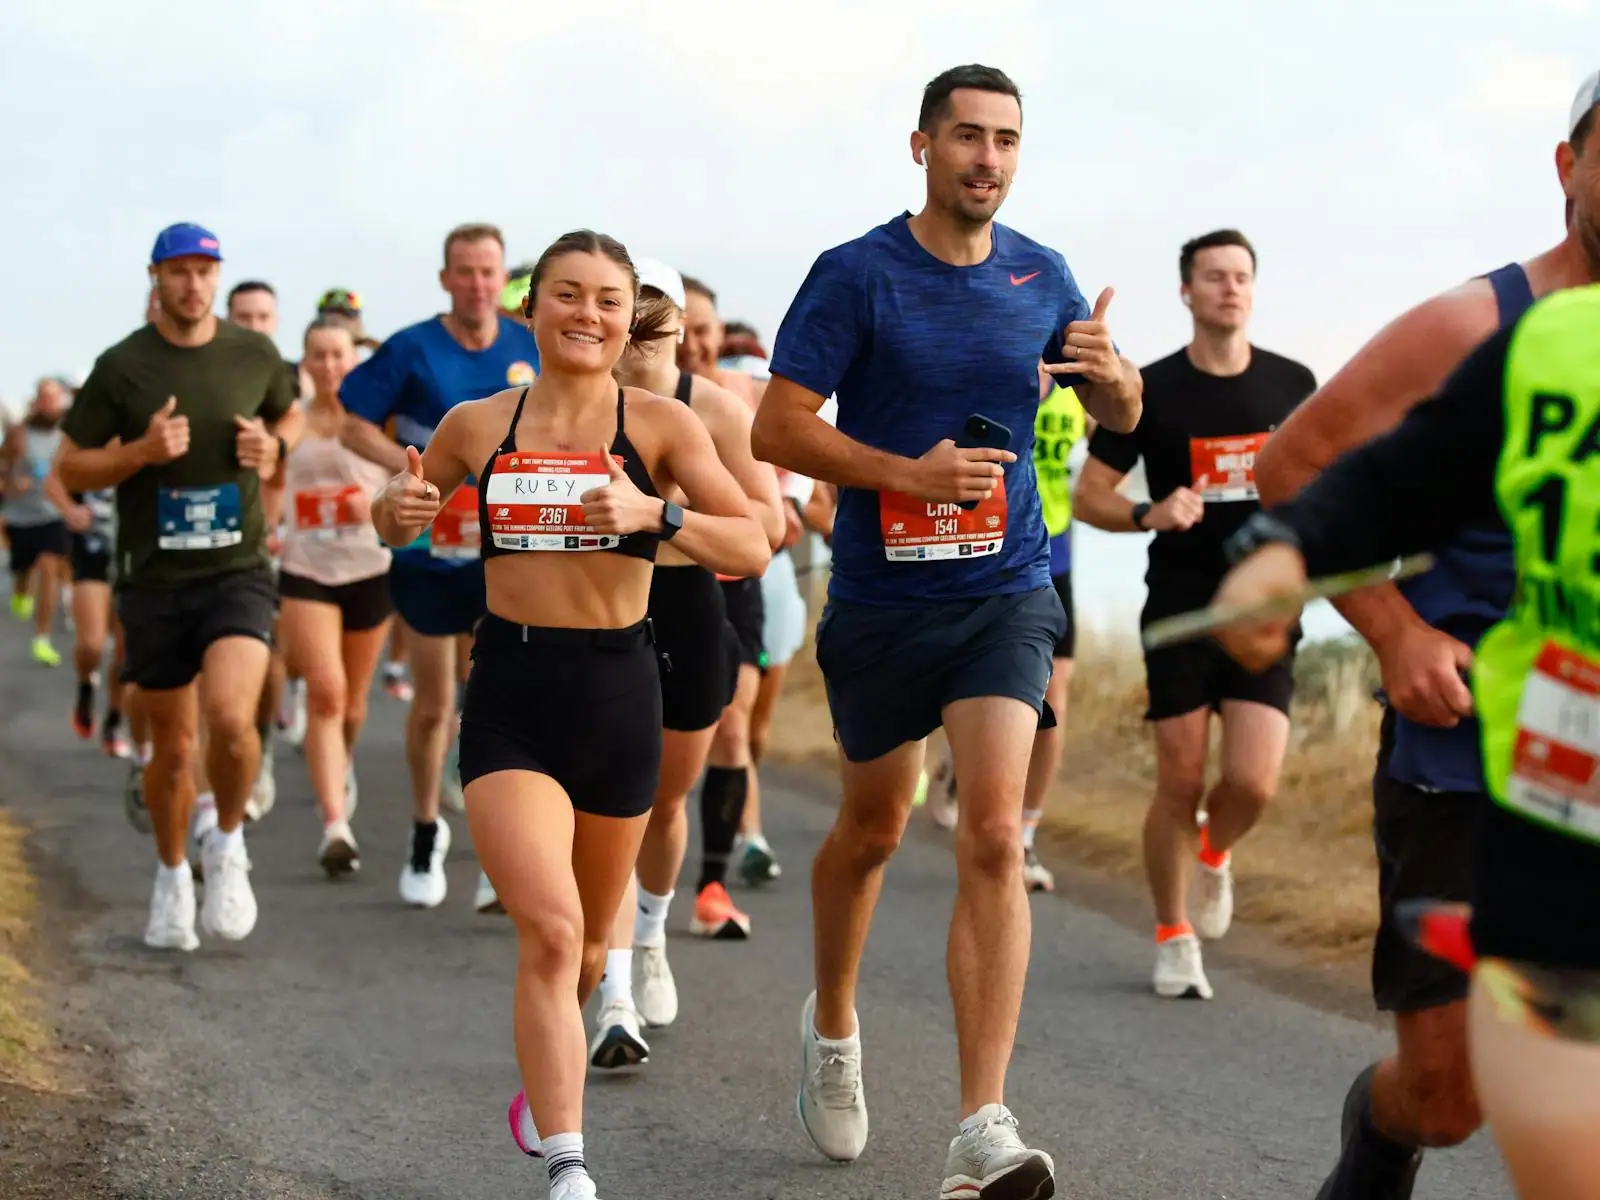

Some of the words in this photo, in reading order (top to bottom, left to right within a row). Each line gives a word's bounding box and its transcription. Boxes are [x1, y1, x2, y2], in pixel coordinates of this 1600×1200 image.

[515, 477, 576, 497] RUBY
[538, 507, 568, 524] 2361
[934, 518, 958, 535] 1541
